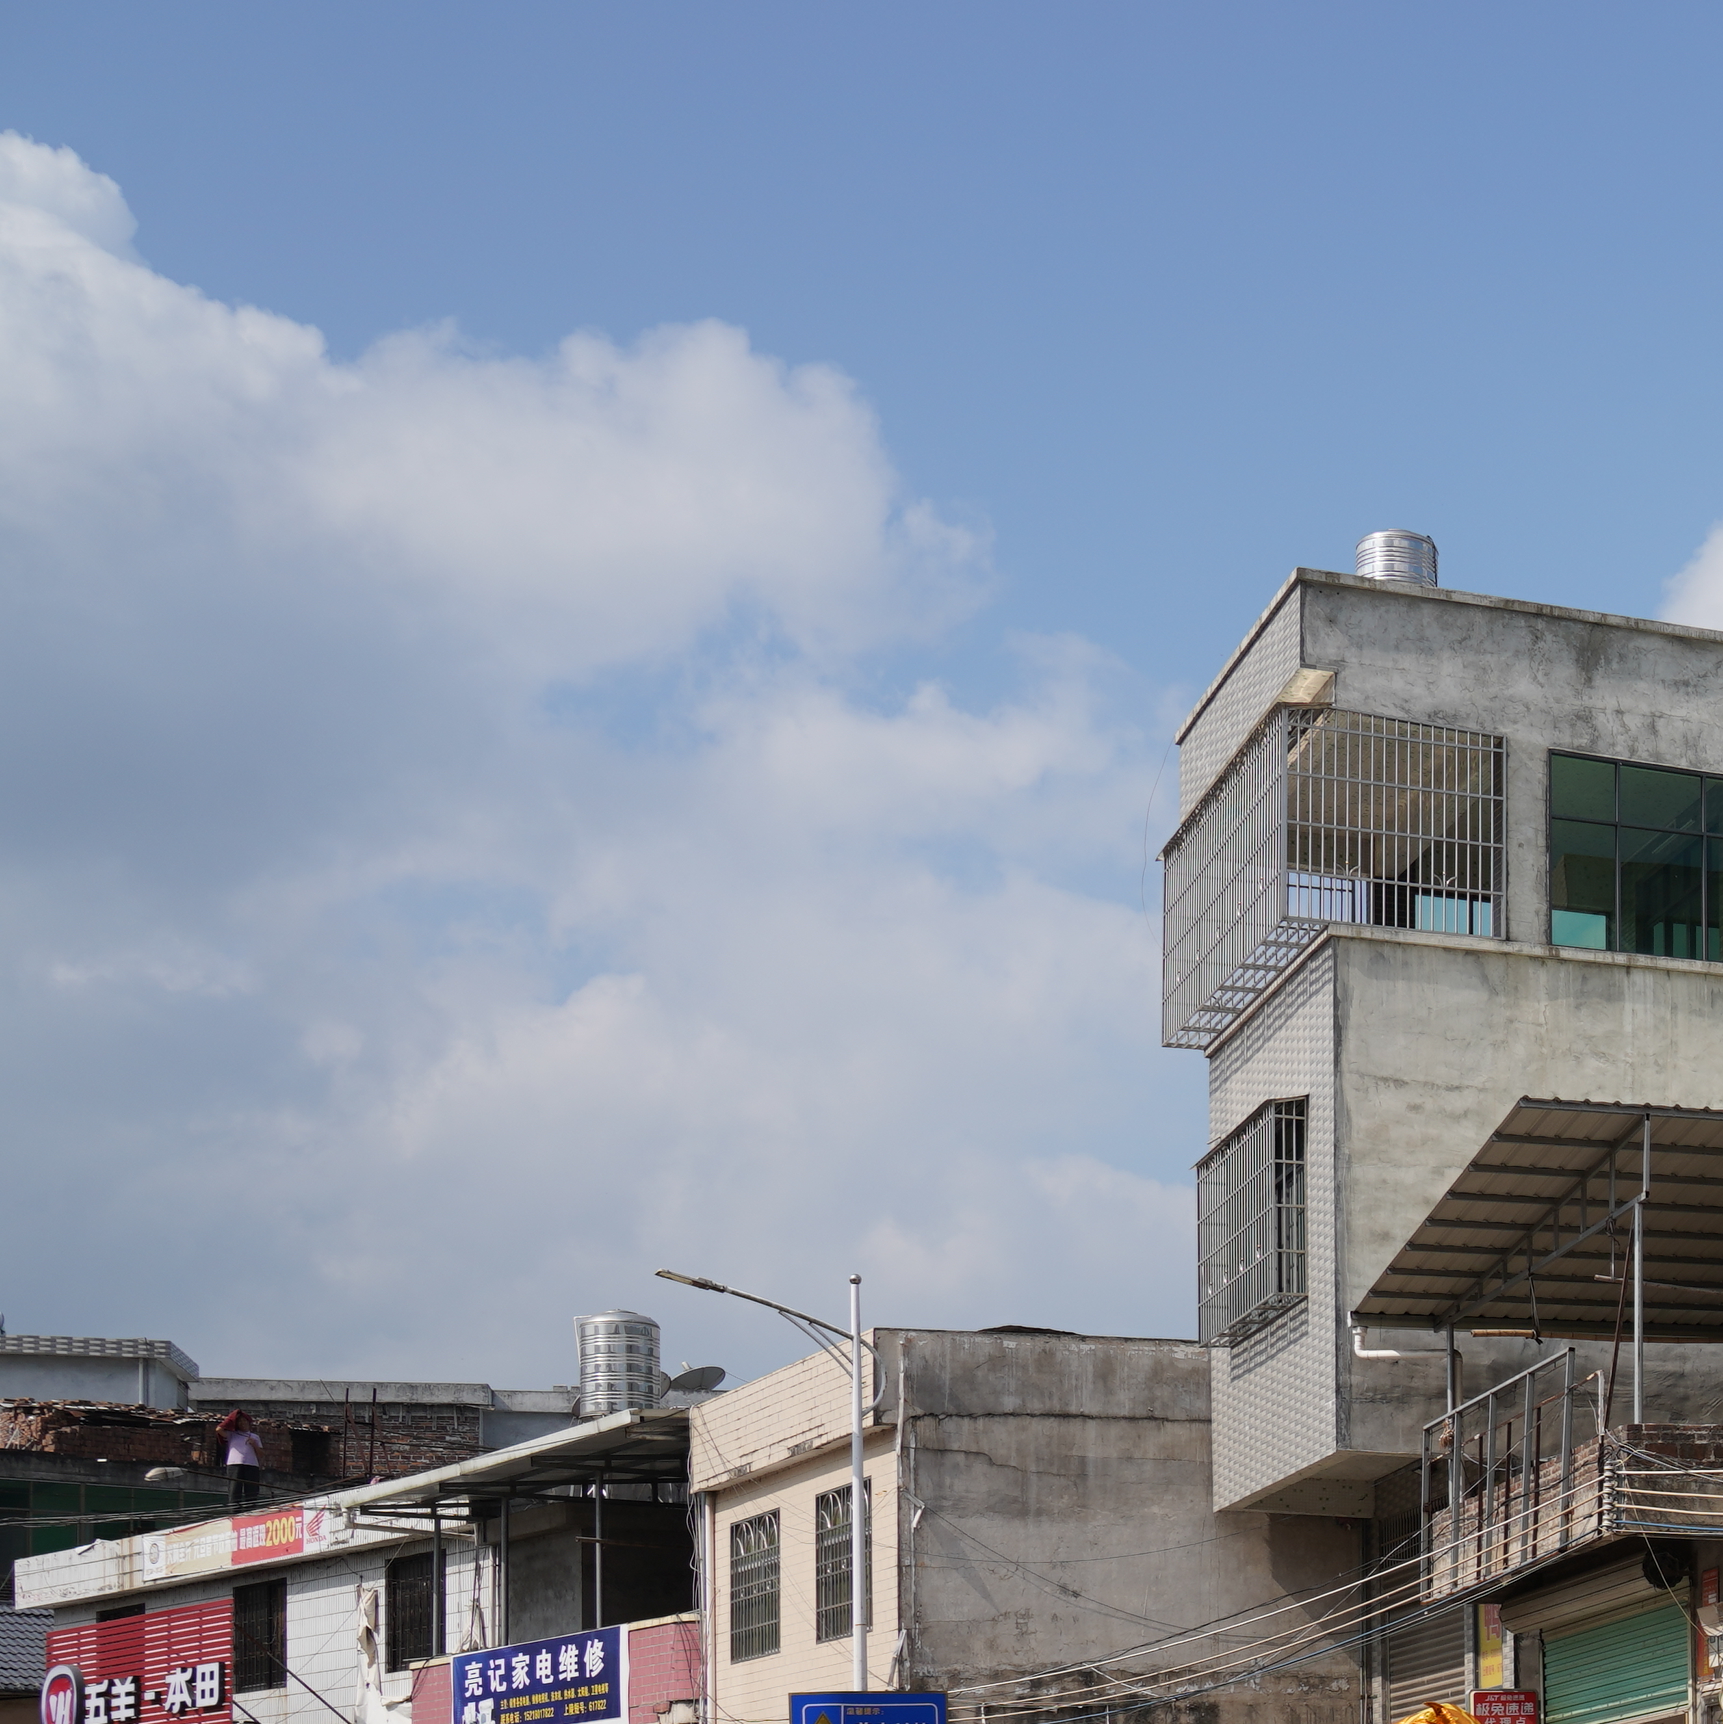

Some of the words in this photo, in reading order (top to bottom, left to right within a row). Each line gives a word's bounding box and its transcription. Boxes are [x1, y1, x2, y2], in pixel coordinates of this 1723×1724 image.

[306, 1535, 327, 1545] HONDA
[464, 1638, 605, 1698] 亮记家电维修
[1476, 1702, 1534, 1716] 极兔速递
